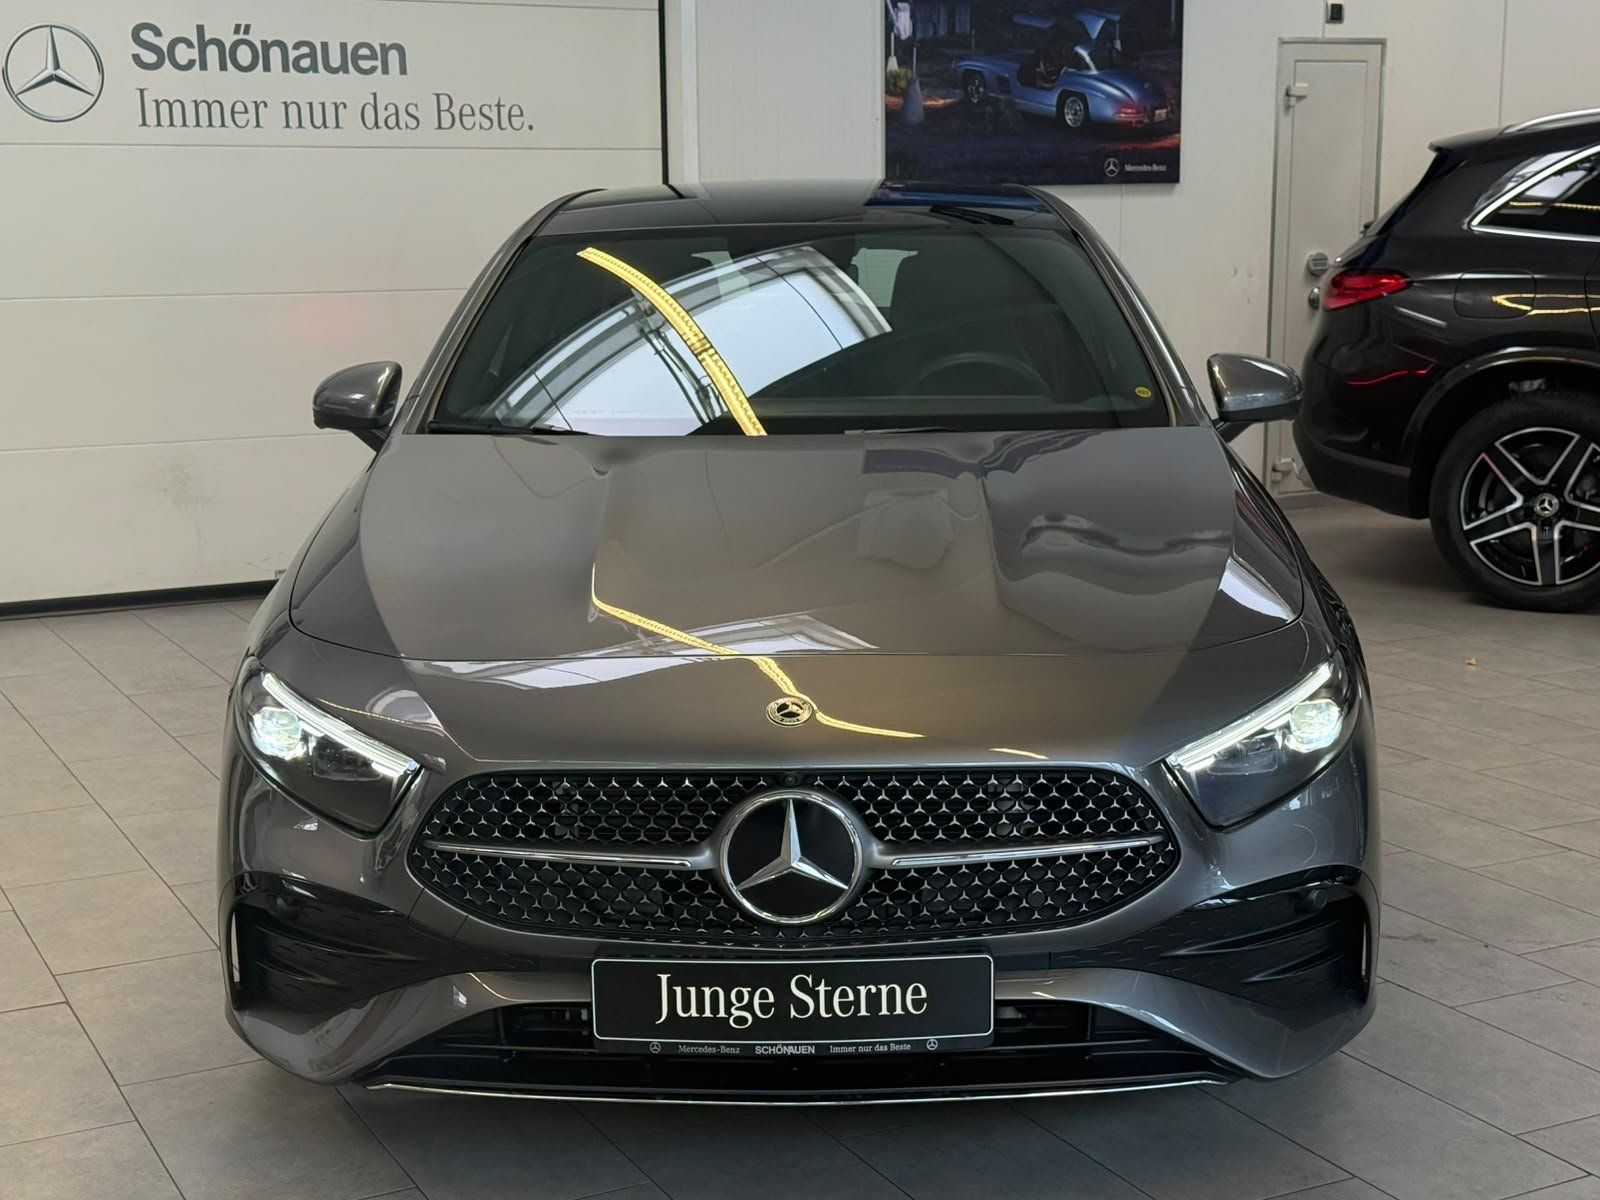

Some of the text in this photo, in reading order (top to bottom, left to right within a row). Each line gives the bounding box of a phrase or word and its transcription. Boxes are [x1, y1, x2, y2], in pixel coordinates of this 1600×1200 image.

[130, 21, 408, 76] Schönauen
[136, 87, 535, 132] Immer nur das Beste.
[655, 973, 928, 1029] Junge Sterne
[678, 1043, 912, 1055] Mercedes-Benz SCHÖNAUEN Immer nur das Beste
